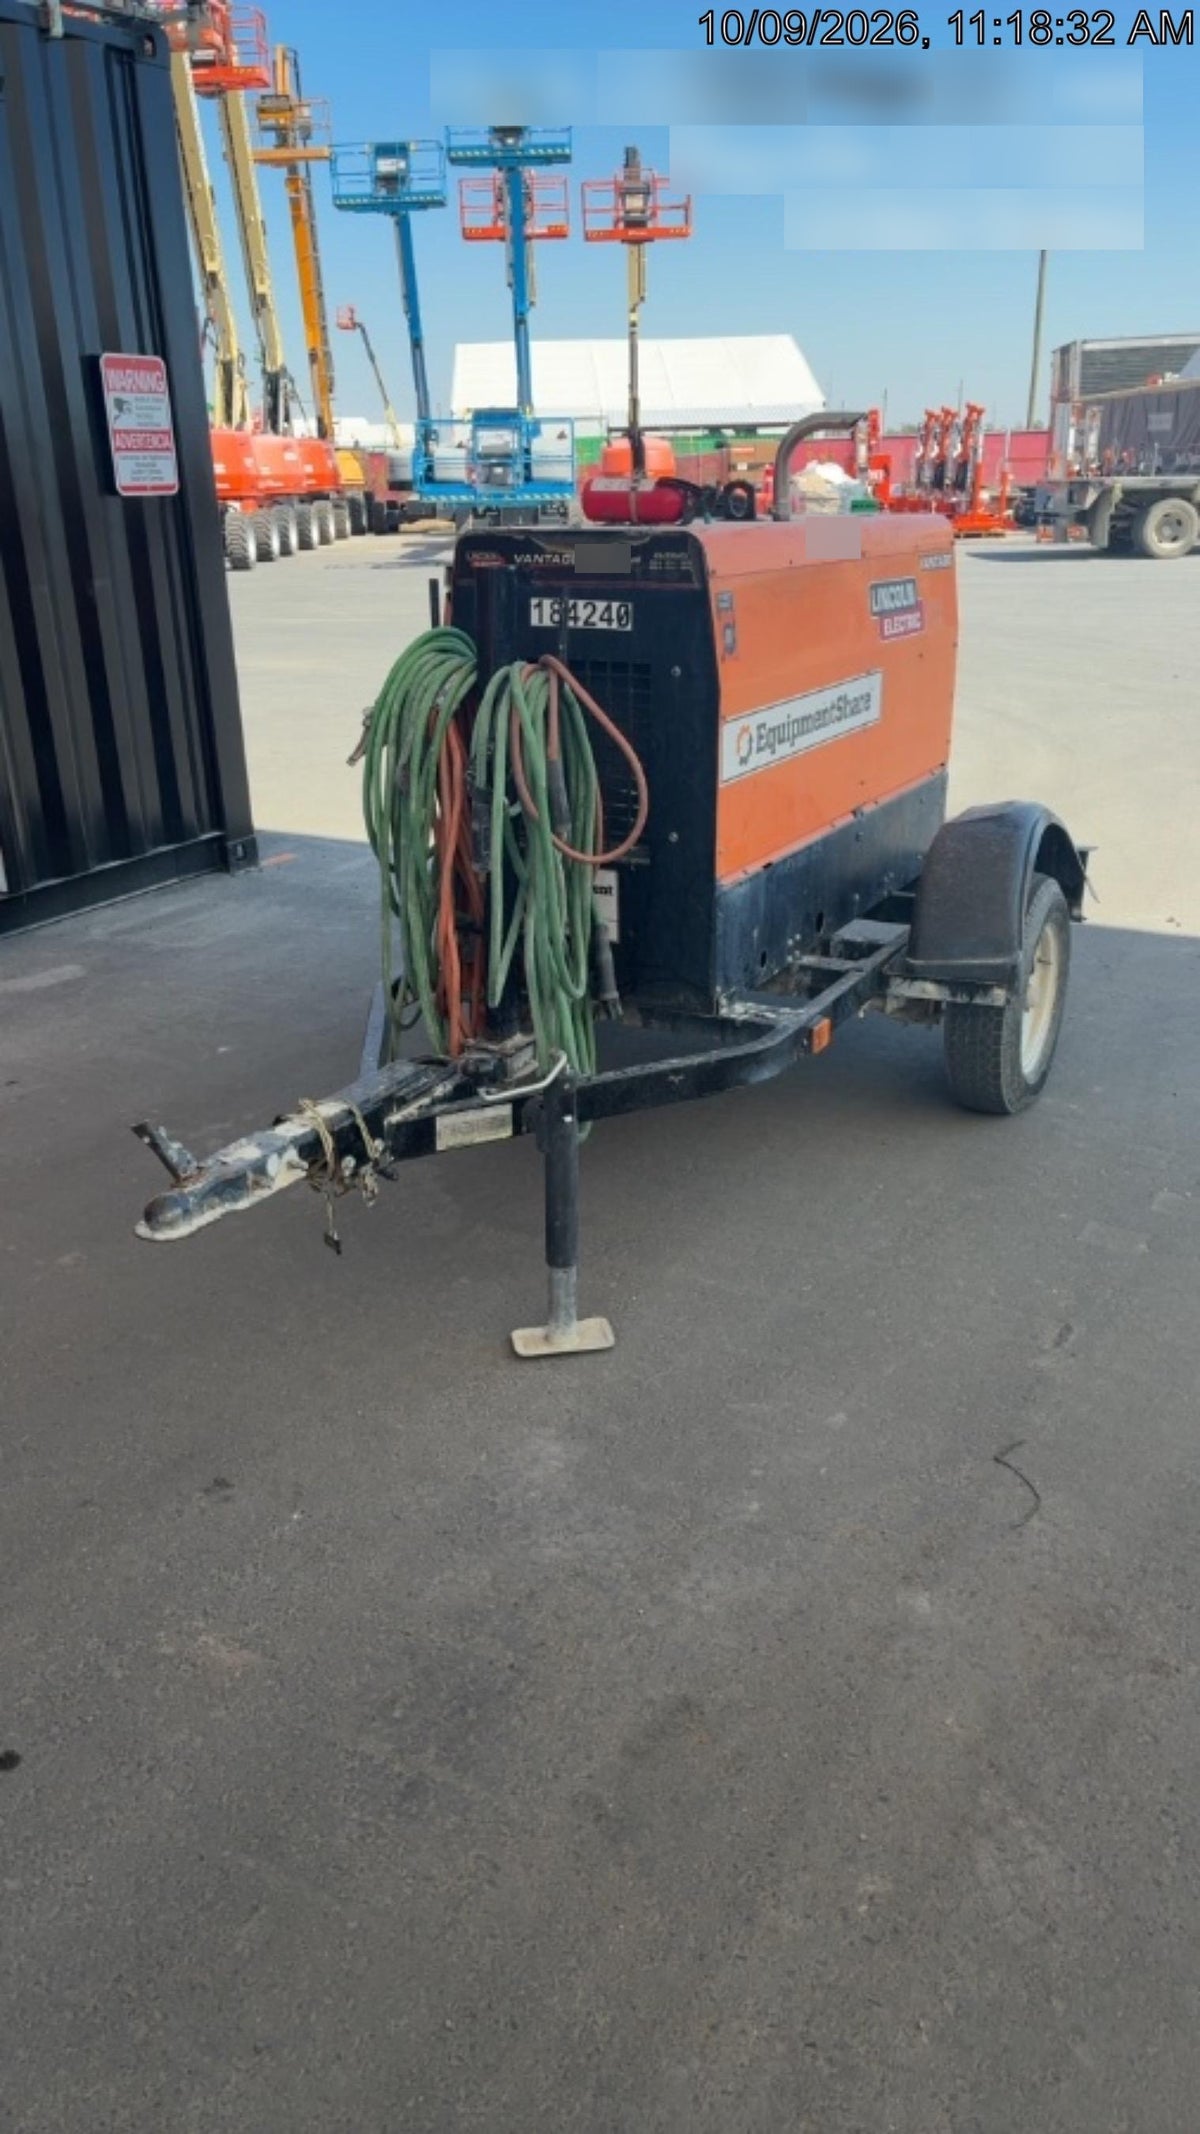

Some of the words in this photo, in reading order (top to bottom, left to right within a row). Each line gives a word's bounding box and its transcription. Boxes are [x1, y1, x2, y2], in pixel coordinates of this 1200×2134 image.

[106, 369, 165, 392] WARNING
[514, 554, 575, 565] VANTAG
[872, 582, 916, 612] LINCOLN
[533, 601, 629, 627] 184240
[884, 612, 921, 636] ELECTRIC
[755, 692, 872, 755] EquipmentShare
